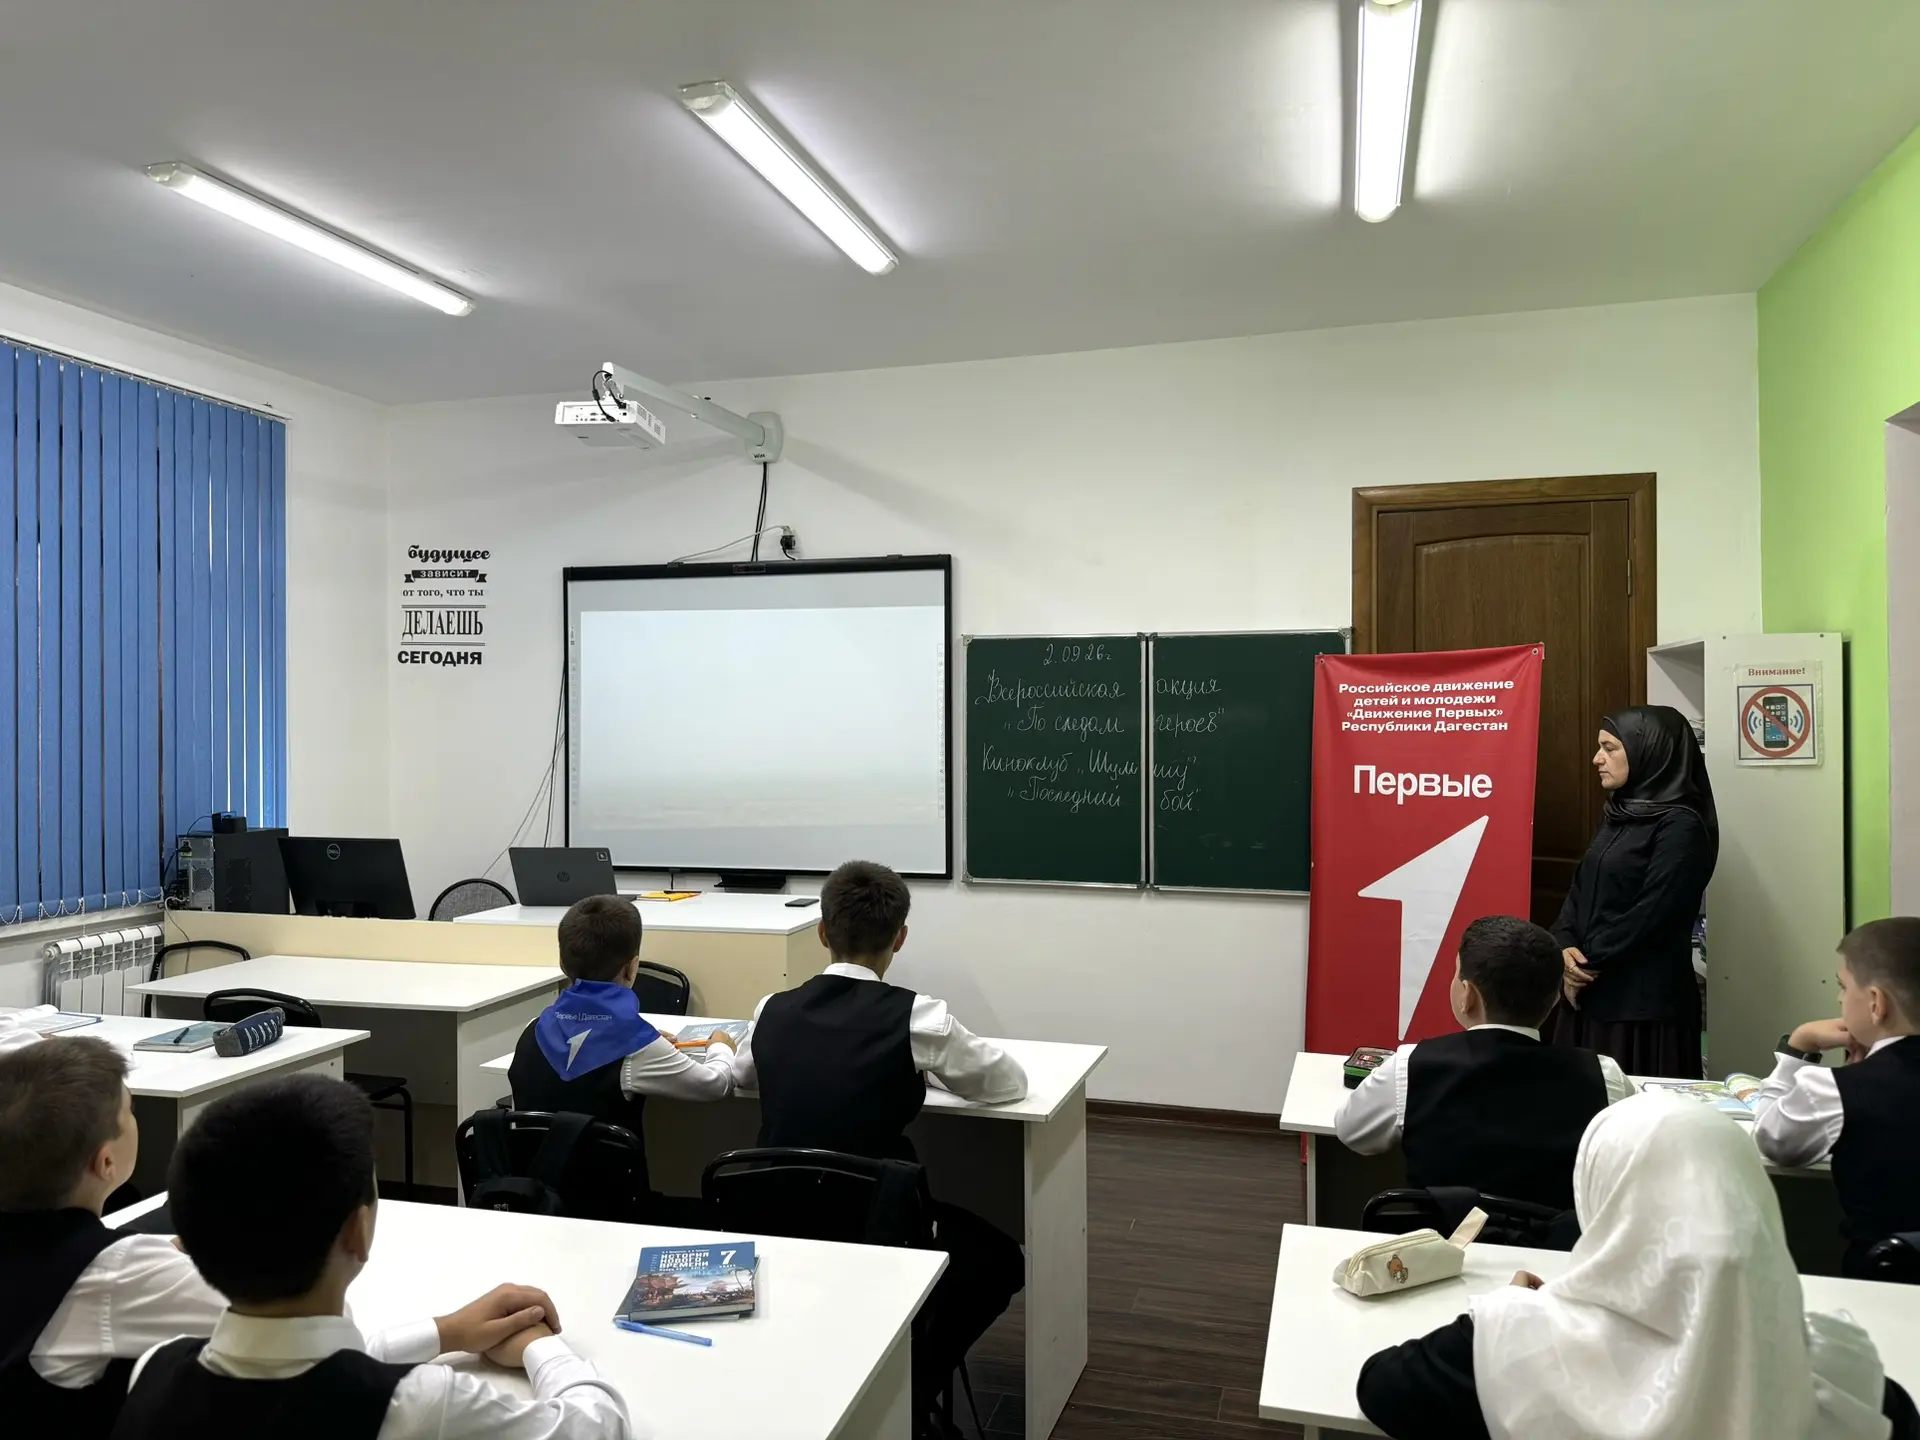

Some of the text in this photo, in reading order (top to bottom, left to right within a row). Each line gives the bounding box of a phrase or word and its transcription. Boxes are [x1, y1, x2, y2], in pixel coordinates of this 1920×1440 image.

[408, 544, 491, 563] будущее
[420, 570, 471, 578] зависит
[402, 589, 484, 598] от того, что ты
[402, 610, 484, 641] ДЕЛАЕШЬ
[397, 650, 482, 667] СЕГОДНЯ
[1748, 667, 1806, 677] Внимание!
[974, 668, 1222, 708] Всероссийская акция
[1338, 680, 1515, 694] Российское движение
[1353, 695, 1497, 708] детей и молодежи
[1346, 707, 1504, 721] «Движение Первых»
[1055, 716, 1125, 743] следам
[1341, 720, 1509, 734] Республики Дагестан
[982, 742, 1073, 782] Киноклуб
[1353, 764, 1493, 805] Первые
[720, 1250, 737, 1265] 7
